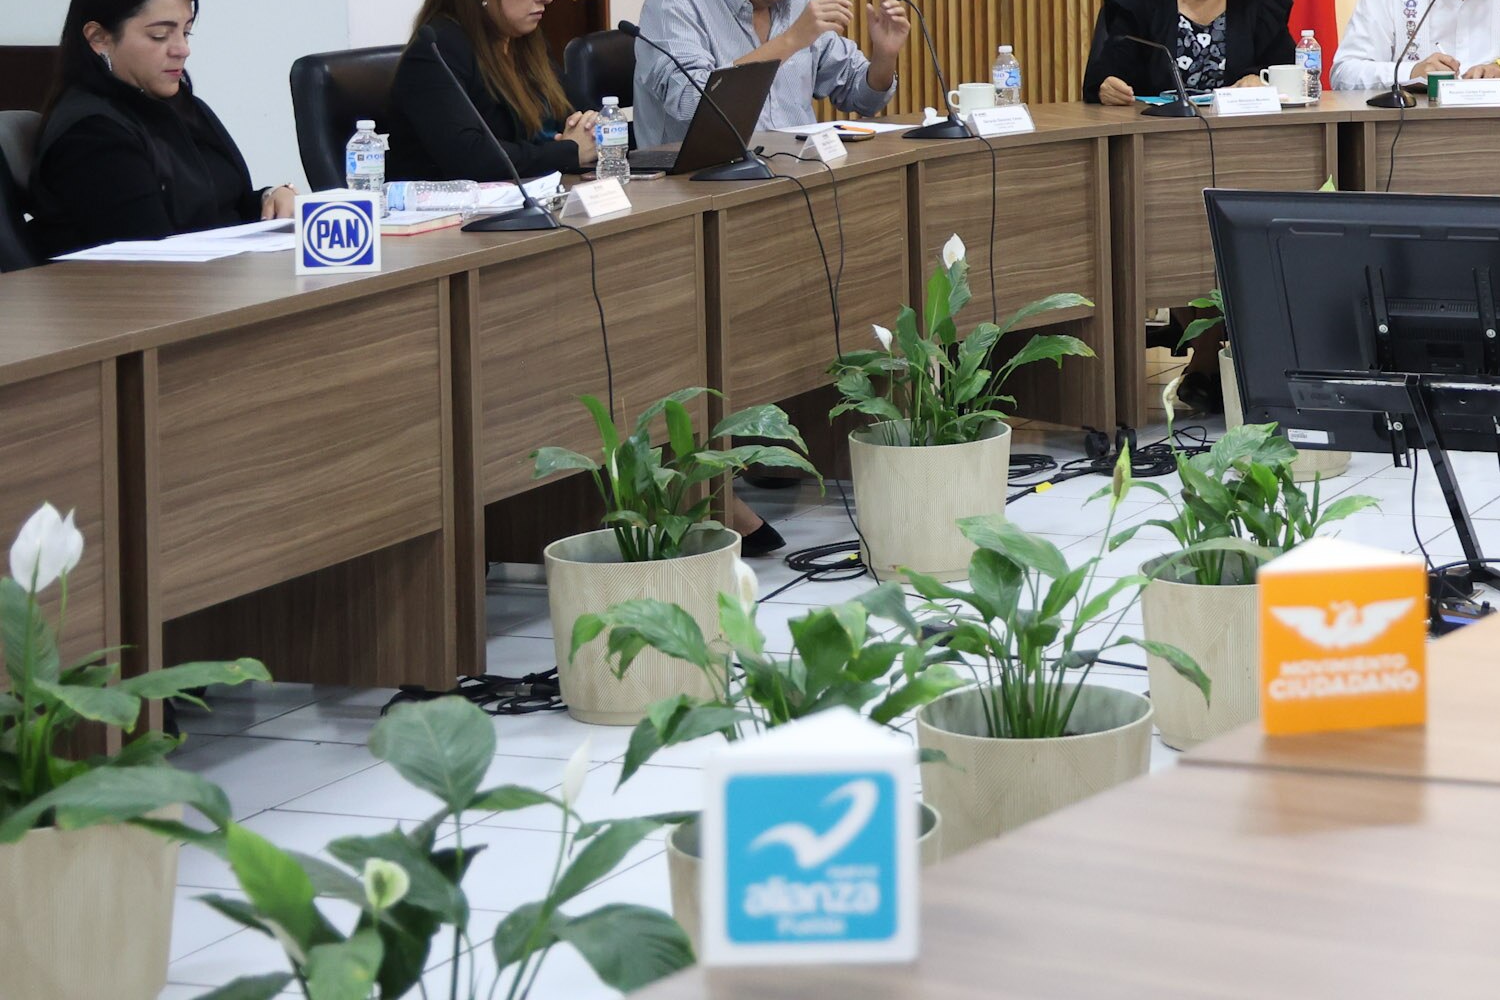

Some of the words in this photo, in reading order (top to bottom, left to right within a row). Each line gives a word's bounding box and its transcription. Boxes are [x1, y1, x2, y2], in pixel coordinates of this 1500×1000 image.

[317, 218, 360, 249] PAN
[1269, 669, 1420, 702] CIUDADANO
[744, 874, 881, 917] alianza
